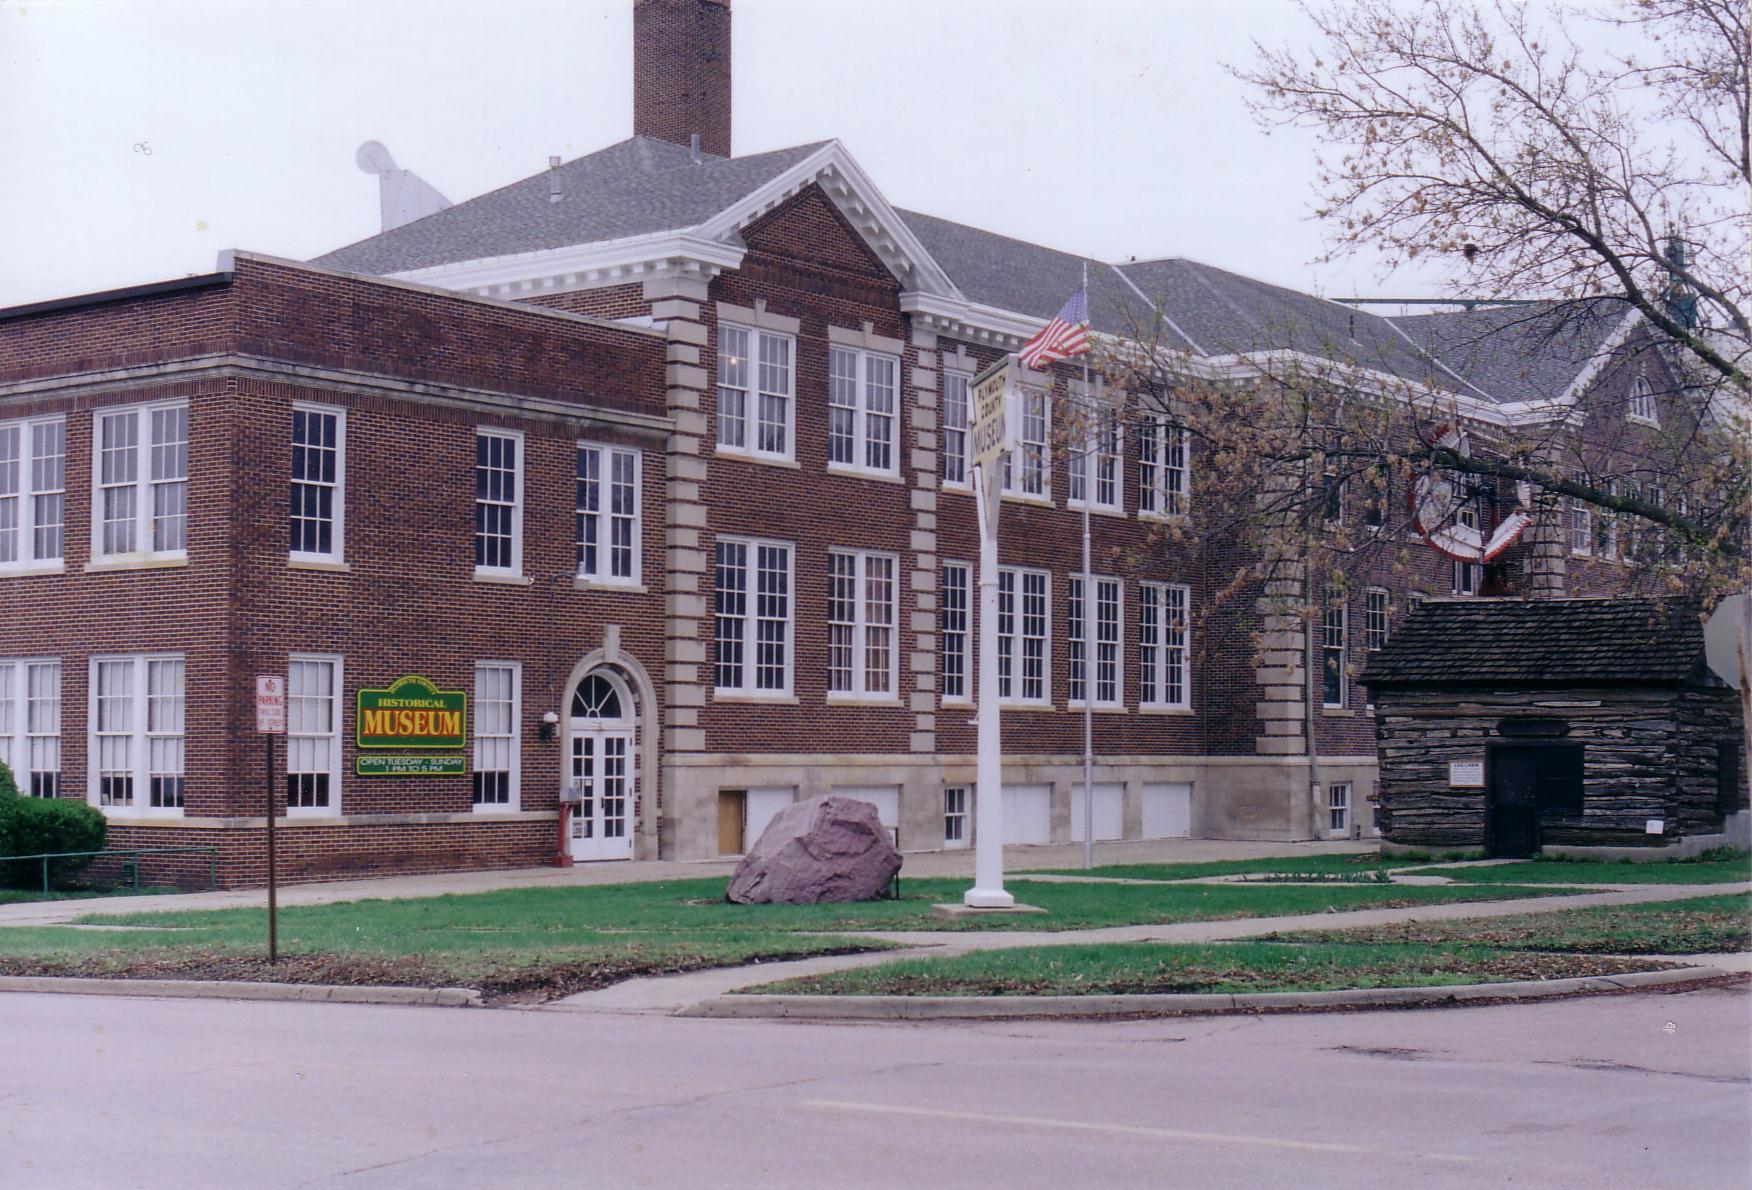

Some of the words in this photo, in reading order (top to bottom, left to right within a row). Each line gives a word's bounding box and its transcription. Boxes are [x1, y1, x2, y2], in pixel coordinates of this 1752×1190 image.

[978, 375, 1006, 401] PLYMOUTH
[981, 394, 1002, 420] COUNTY
[265, 681, 276, 693] NO
[258, 695, 283, 705] PARKING
[378, 698, 447, 708] HISTORICAL
[364, 709, 461, 736] MUSEUM
[360, 758, 385, 766] OPEN
[387, 758, 423, 766] TUESDAY
[430, 758, 463, 766] SUNDAY
